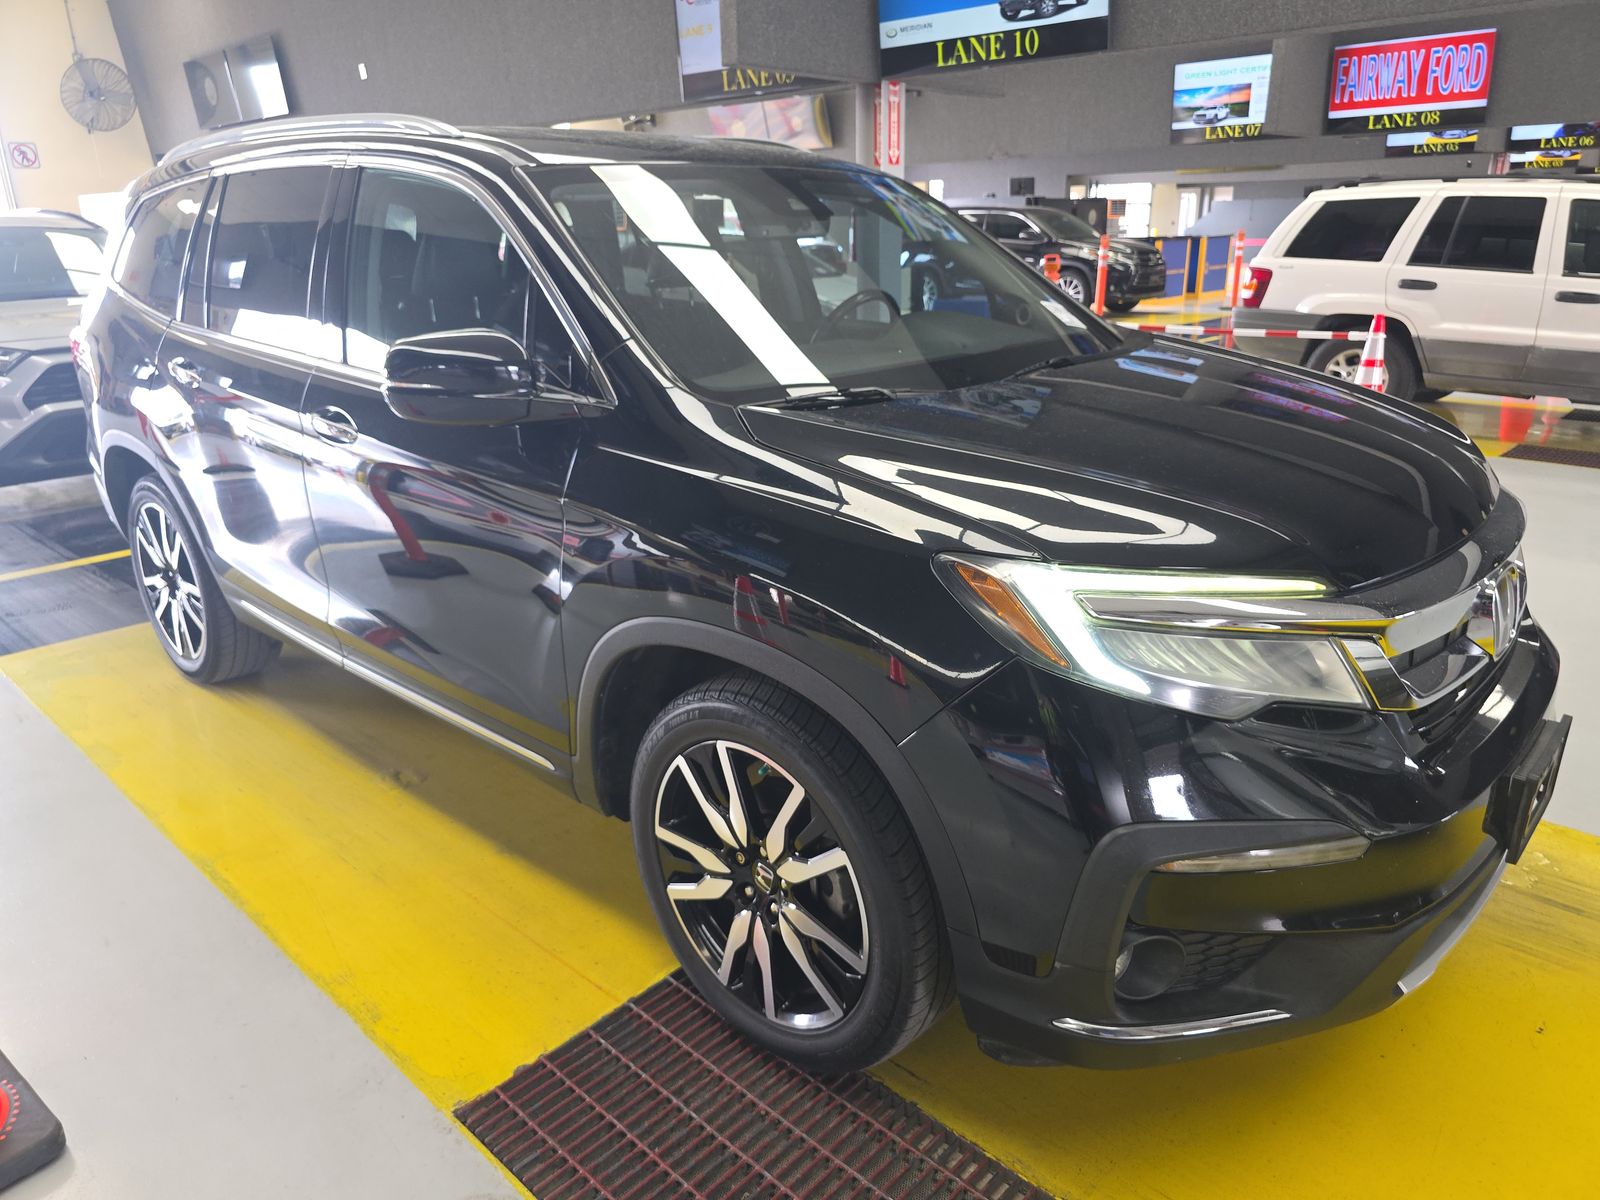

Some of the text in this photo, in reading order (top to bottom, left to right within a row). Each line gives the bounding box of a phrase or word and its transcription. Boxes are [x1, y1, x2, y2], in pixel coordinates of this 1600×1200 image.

[936, 28, 1039, 67] LANE 10
[721, 67, 773, 92] LANE
[1184, 71, 1212, 80] GREEN
[1214, 67, 1237, 77] LIGHT
[1334, 42, 1488, 103] FAIRWAY FORD
[1367, 110, 1441, 130] LANE 08
[1205, 123, 1262, 140] LANE 07
[1413, 143, 1446, 154] LANE
[1540, 135, 1595, 148] LANE 06
[1525, 160, 1551, 169] LANE
